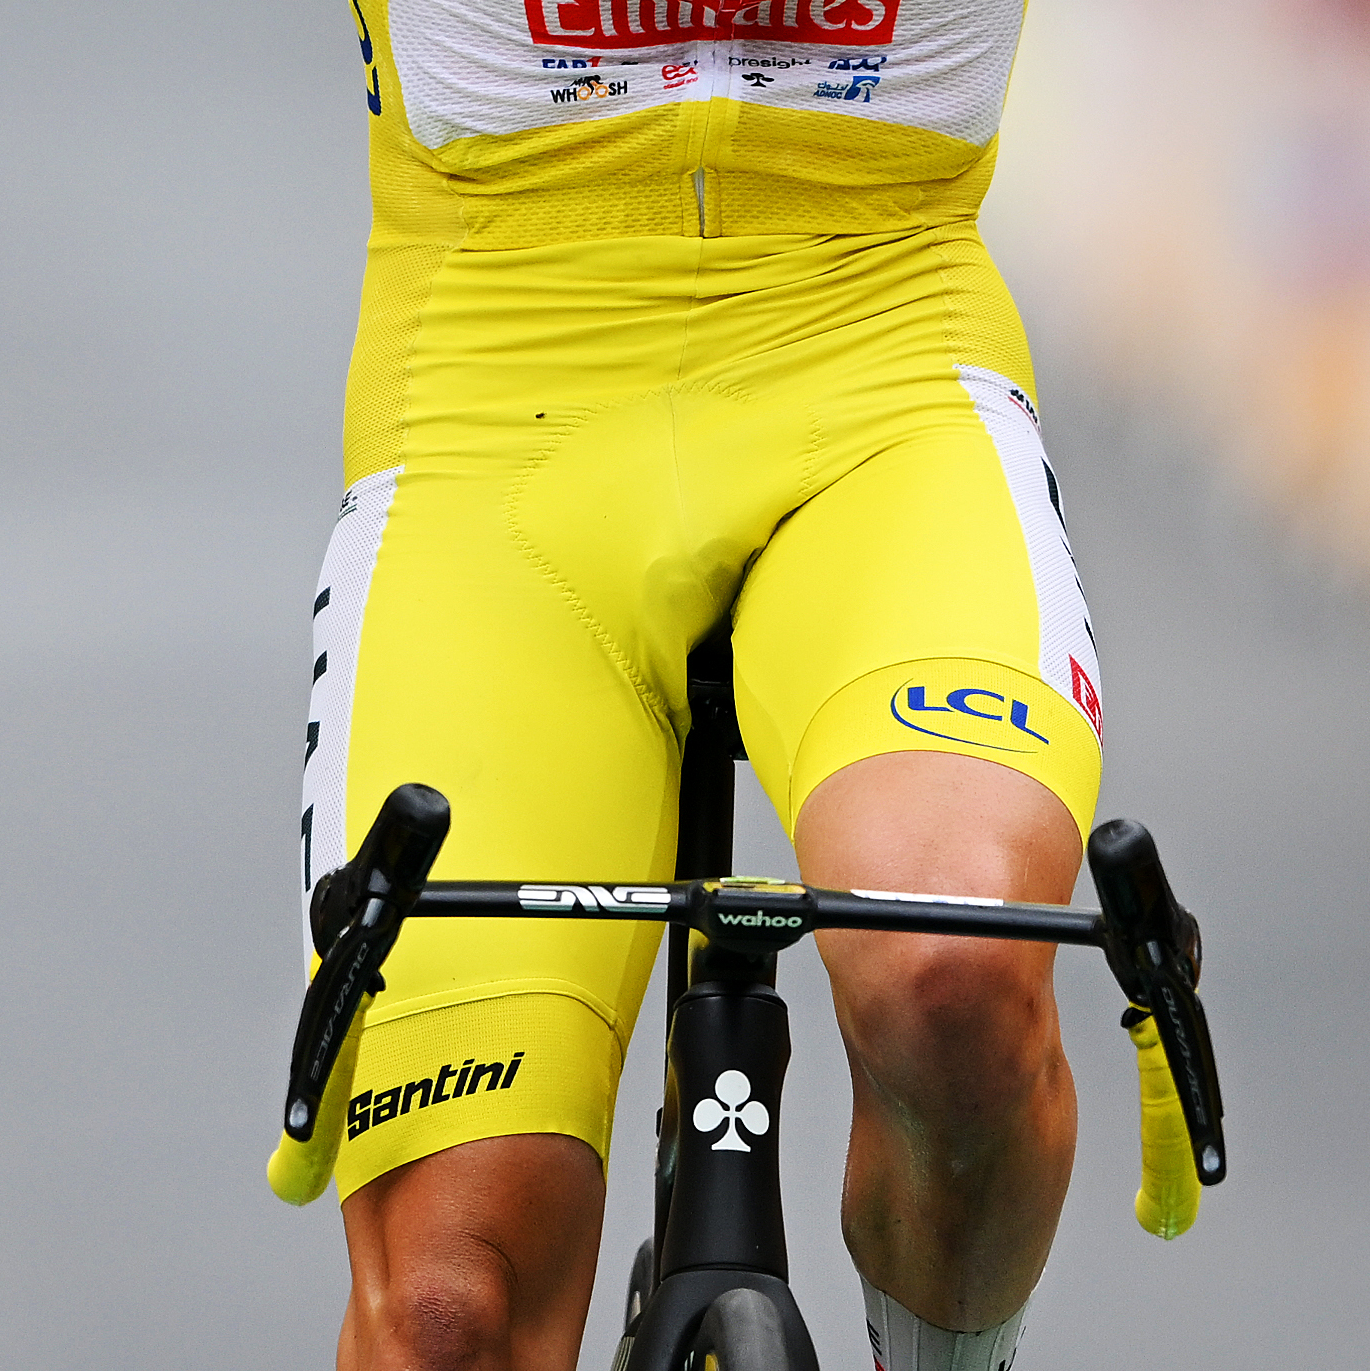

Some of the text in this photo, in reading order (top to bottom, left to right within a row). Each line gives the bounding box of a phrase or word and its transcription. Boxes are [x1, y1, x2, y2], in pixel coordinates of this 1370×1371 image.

[907, 685, 1051, 746] LCL
[718, 910, 803, 928] wahoo
[347, 1051, 526, 1143] Santini
